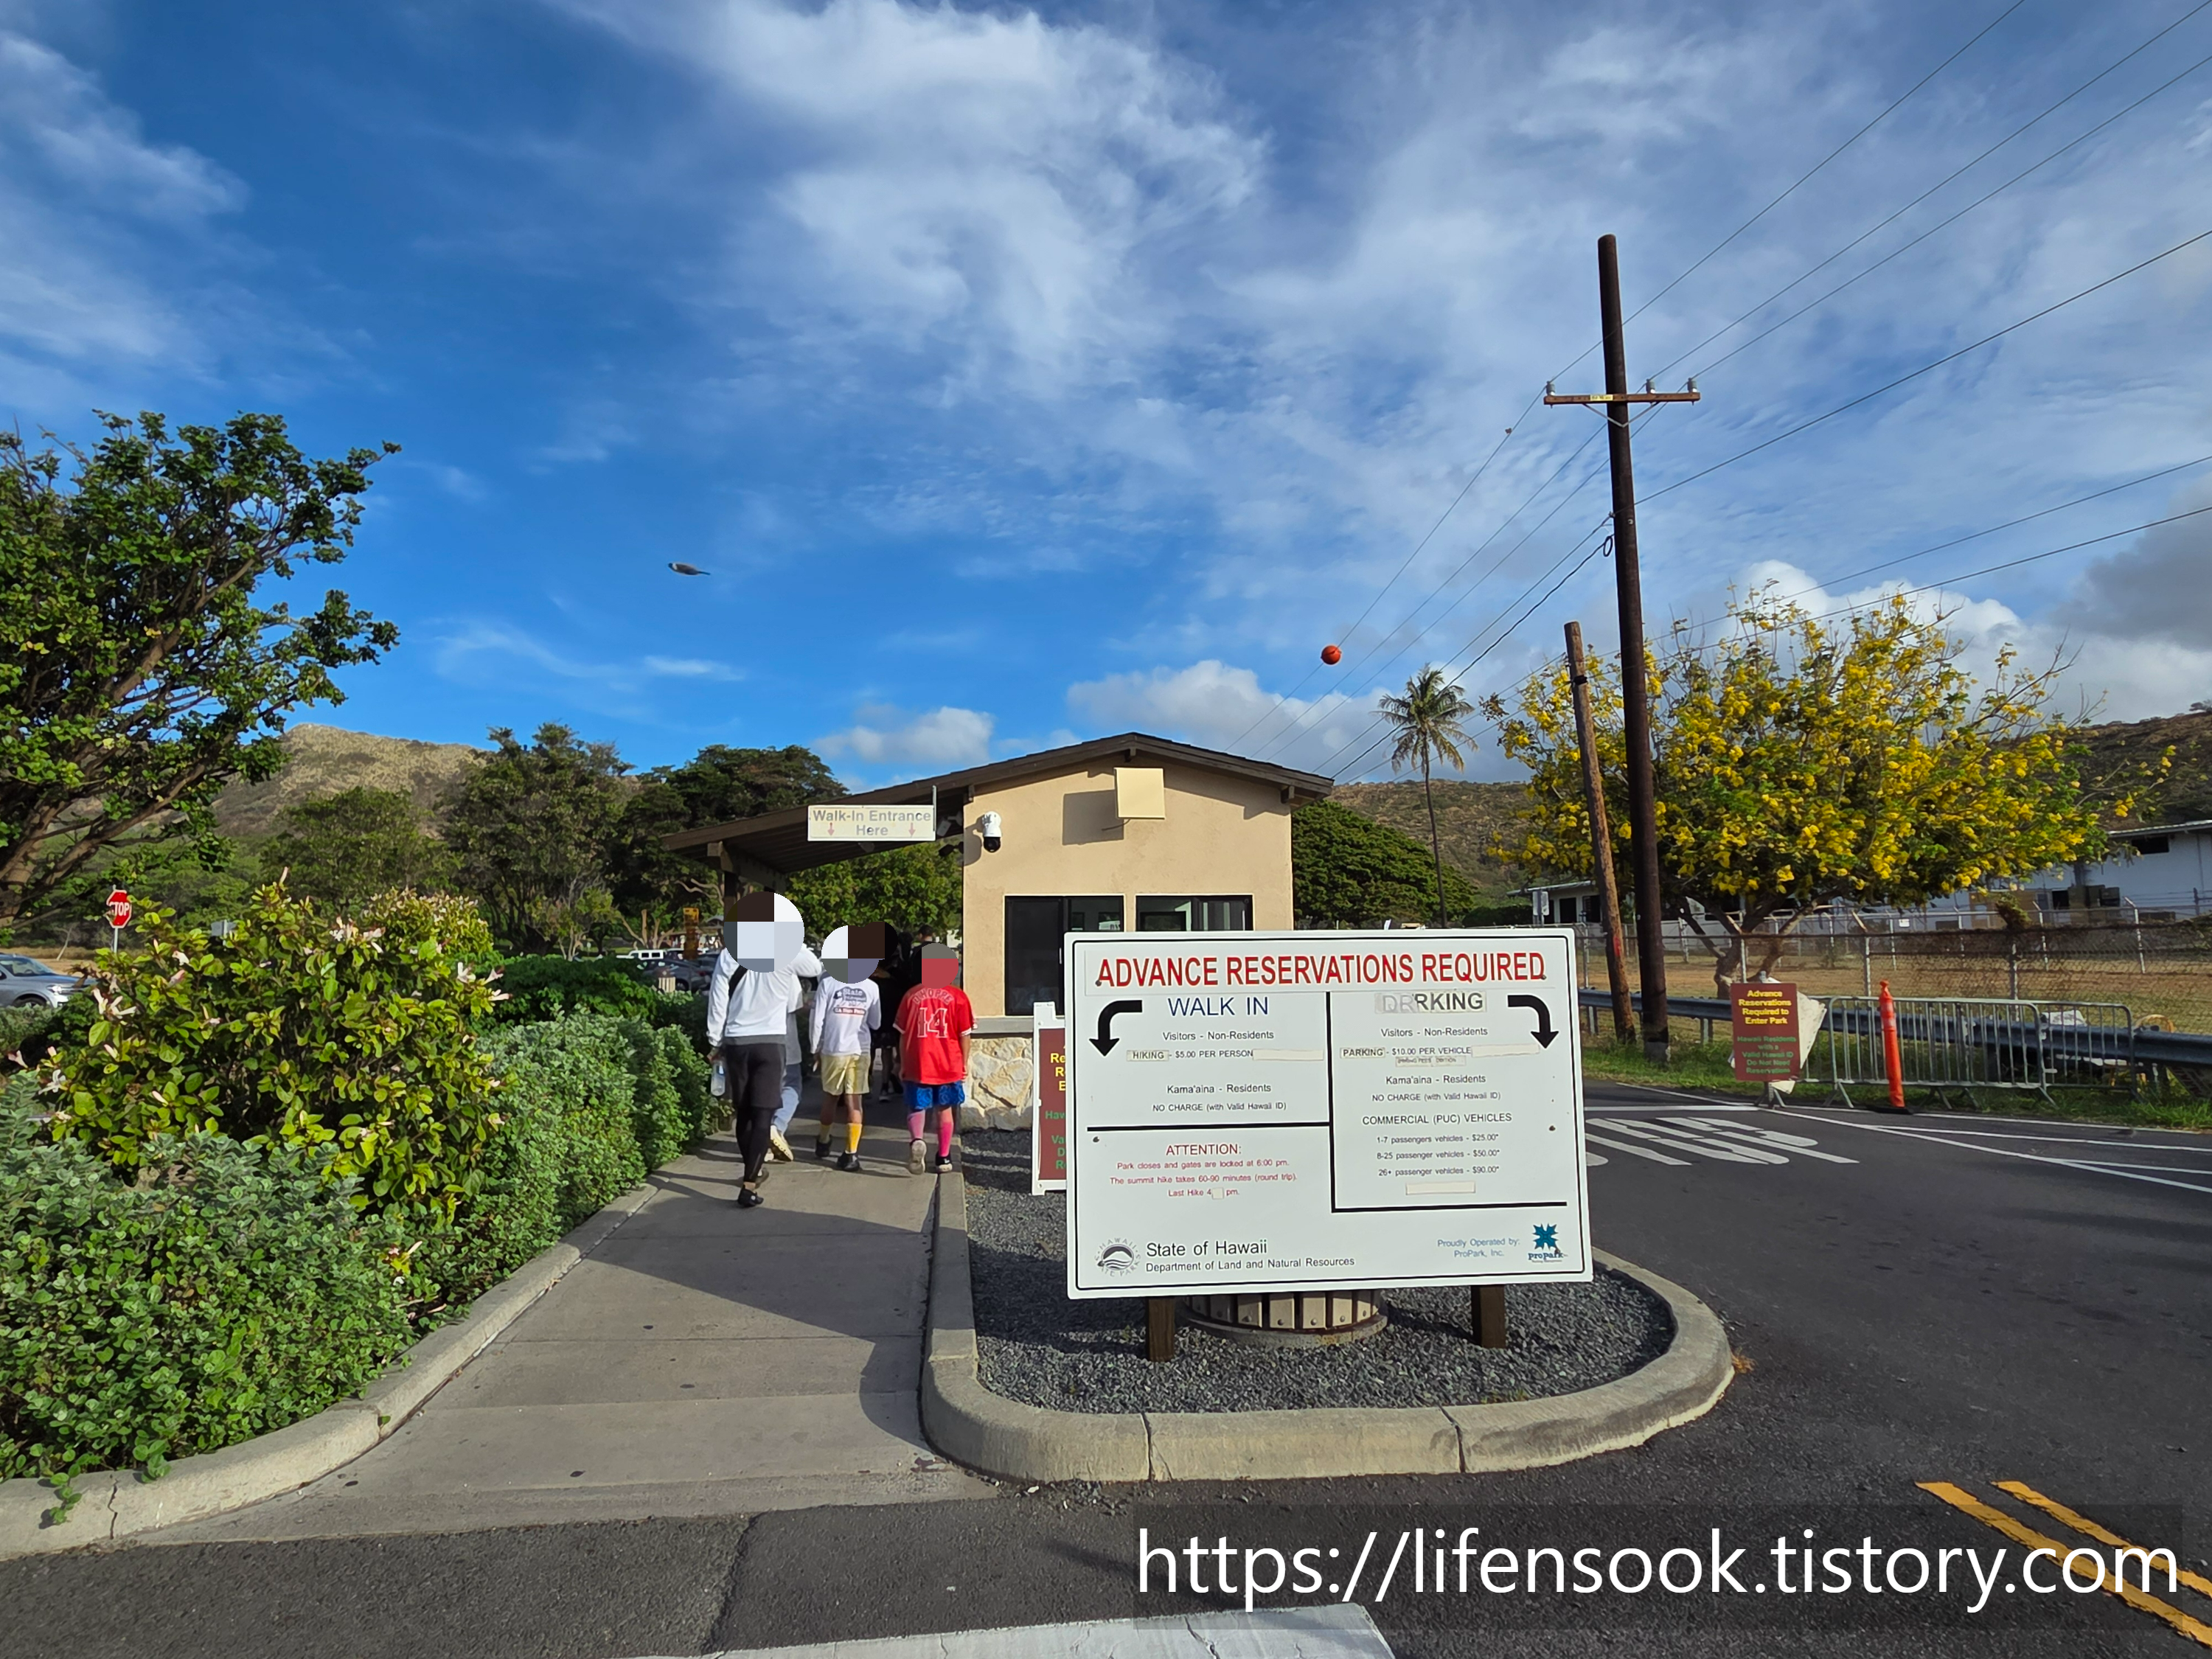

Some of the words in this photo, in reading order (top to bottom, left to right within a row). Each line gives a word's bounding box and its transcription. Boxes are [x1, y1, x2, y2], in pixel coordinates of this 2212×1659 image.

[813, 810, 863, 821] Walk-In
[869, 810, 931, 821] Entrance
[856, 824, 888, 835] Here
[1098, 957, 1218, 987] ADVANCE
[1227, 954, 1413, 986] RESERVATIONS
[1422, 953, 1546, 983] REQUIRED
[1168, 998, 1235, 1016] WALK
[1247, 996, 1269, 1015] IN
[1742, 1008, 1780, 1016] Required
[917, 1007, 948, 1037] 14
[1163, 1032, 1196, 1041] Visitors
[1208, 1030, 1274, 1040] Non-Residents
[1381, 1029, 1413, 1037] Visitors
[1425, 1026, 1488, 1037] Non-Residents
[1133, 1051, 1164, 1060] HIKING
[1175, 1050, 1196, 1059] $5.00
[1343, 1049, 1383, 1057] PARKING
[1392, 1047, 1416, 1056] $10.00
[1419, 1047, 1436, 1055] PER
[1438, 1046, 1471, 1055] VEHICLE
[1386, 1075, 1432, 1085] Kama'aina
[1443, 1074, 1486, 1084] Residents
[1166, 1085, 1214, 1094] Kama'aina
[1227, 1084, 1271, 1093] Residents
[1372, 1094, 1385, 1102] NO
[1388, 1093, 1421, 1102] CHARGE
[1425, 1093, 1441, 1102] (with
[1464, 1092, 1487, 1100] Hawaii
[1490, 1092, 1501, 1101] ID)
[1152, 1105, 1165, 1113] NO
[1168, 1104, 1203, 1112] CHARGE
[1206, 1103, 1224, 1112] (with
[1227, 1103, 1245, 1111] Valid
[1248, 1102, 1272, 1110] Hawaii
[1275, 1102, 1287, 1111] ID)
[1363, 1115, 1429, 1125] COMMERCIAL
[1433, 1114, 1461, 1126] (PUC)
[1464, 1113, 1512, 1123] VEHICLES
[1391, 1136, 1432, 1145] passengers
[1434, 1134, 1463, 1142] vehicles
[1166, 1144, 1242, 1156] ATTENTION:
[1377, 1152, 1393, 1160] 8-25
[1396, 1152, 1433, 1161] passenger
[1436, 1150, 1464, 1158] vehicles
[1181, 1161, 1201, 1170] gates
[1256, 1159, 1273, 1167] 6:00
[1276, 1160, 1290, 1168] pm.
[1378, 1169, 1392, 1177] 26+
[1395, 1168, 1433, 1178] passenger
[1435, 1166, 1464, 1175] vehicles
[1127, 1176, 1154, 1184] summit
[1198, 1175, 1220, 1183] 60-90
[1222, 1174, 1251, 1182] minutes
[1254, 1174, 1279, 1183] (round
[1099, 1237, 1137, 1250] HAWAII
[1147, 1242, 1186, 1257] State
[1193, 1242, 1208, 1256] of
[1216, 1239, 1267, 1255] Hawaii
[1438, 1239, 1467, 1248] Proudly
[1470, 1238, 1506, 1247] Operated
[1509, 1238, 1520, 1247] by:
[1146, 1262, 1202, 1273] Department
[1205, 1261, 1214, 1270] of
[1218, 1259, 1242, 1270] Land
[1246, 1259, 1264, 1269] and
[1267, 1259, 1301, 1268] Natural
[1306, 1257, 1354, 1267] Resources
